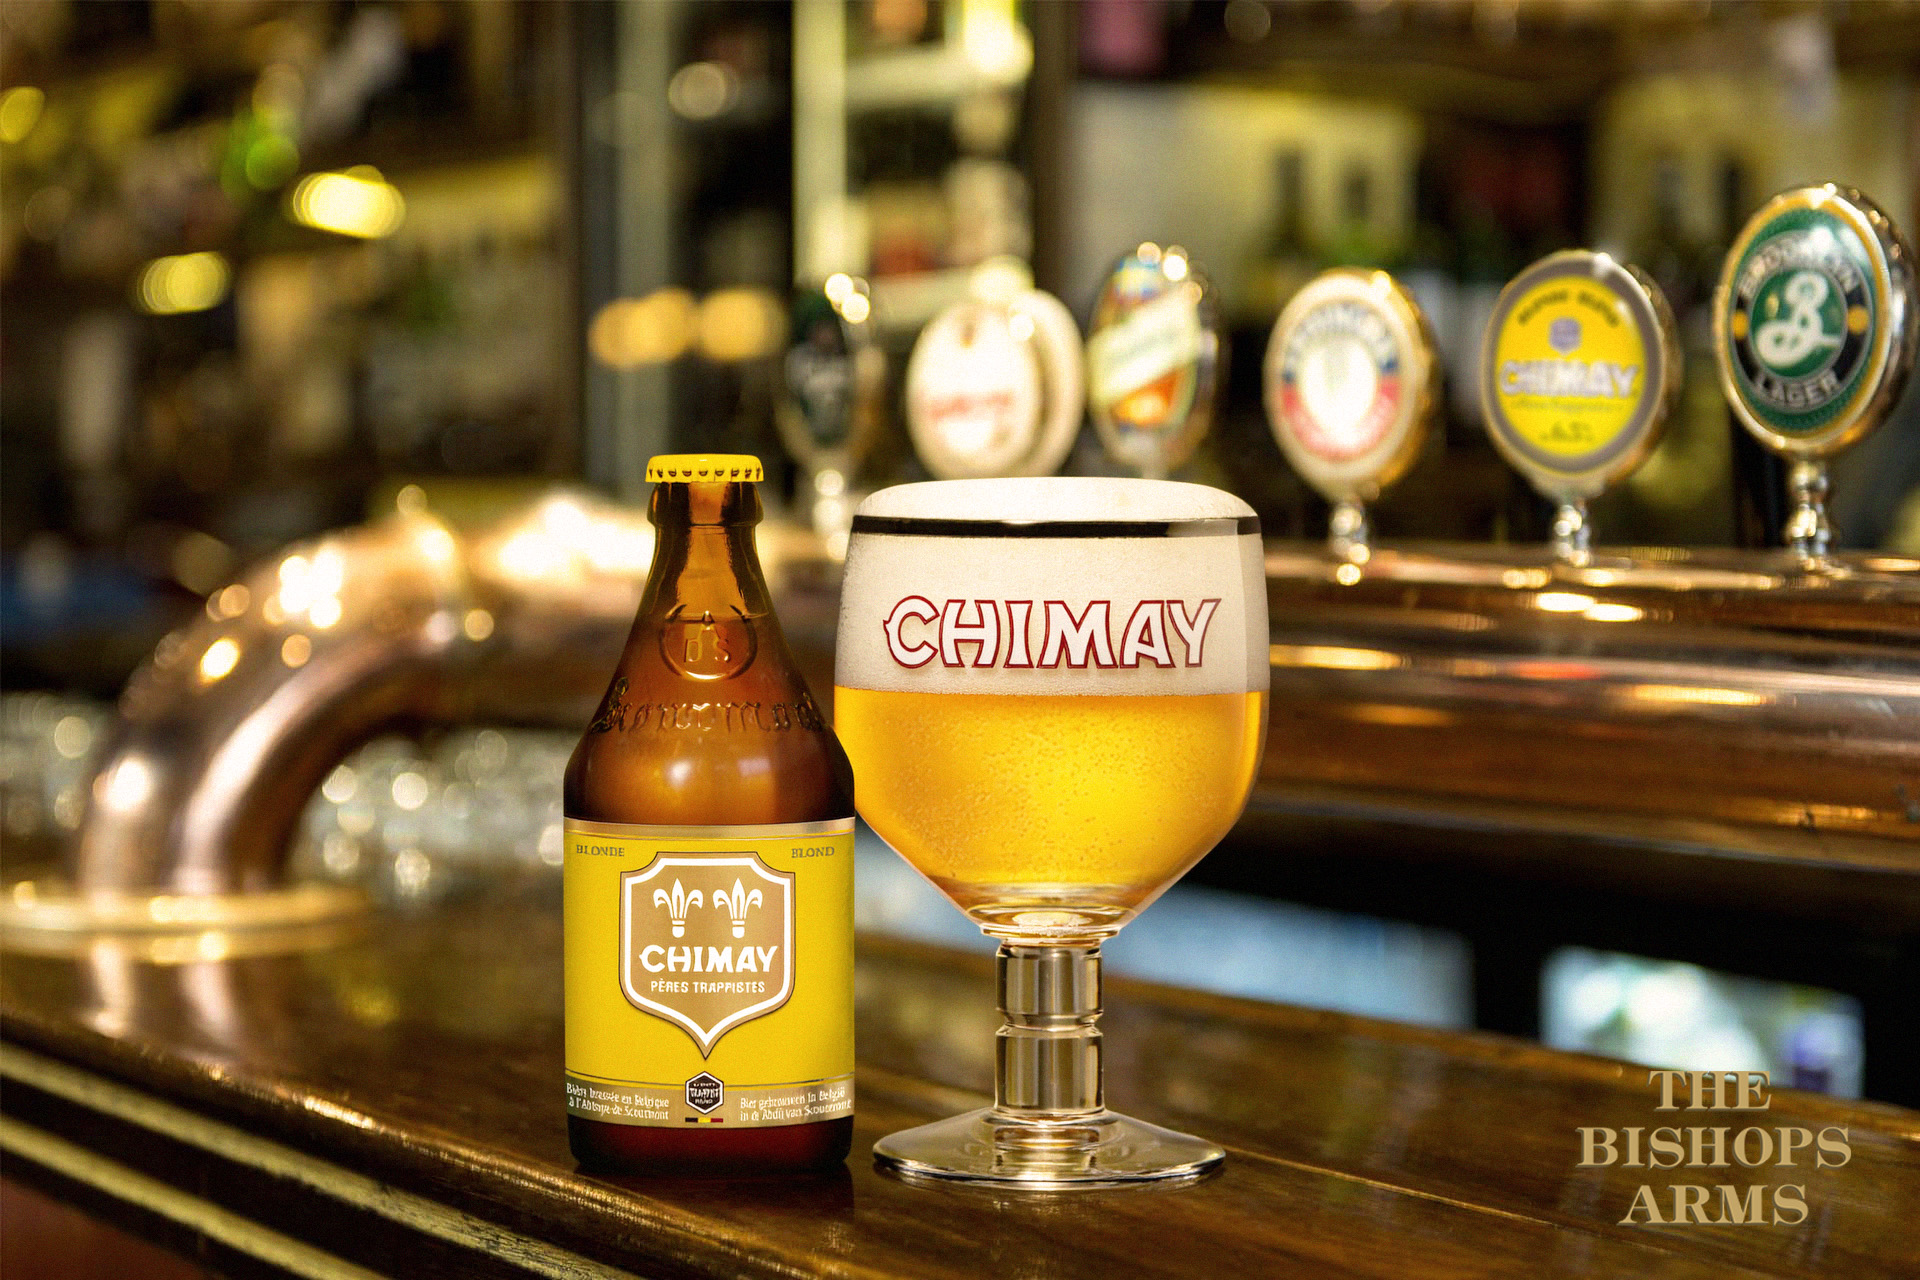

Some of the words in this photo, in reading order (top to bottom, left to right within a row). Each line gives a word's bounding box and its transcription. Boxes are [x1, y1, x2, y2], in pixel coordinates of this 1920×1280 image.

[1738, 231, 1860, 298] BROOYN
[1501, 359, 1639, 399] CHIMAY
[1756, 370, 1840, 408] LAGER
[883, 595, 1222, 669] CHIMAY
[575, 844, 625, 857] BLONDE
[791, 846, 835, 859] BLOND
[639, 945, 778, 973] CHIMAY
[650, 978, 689, 993] PÈRES
[692, 981, 766, 994] TRAPPISTES
